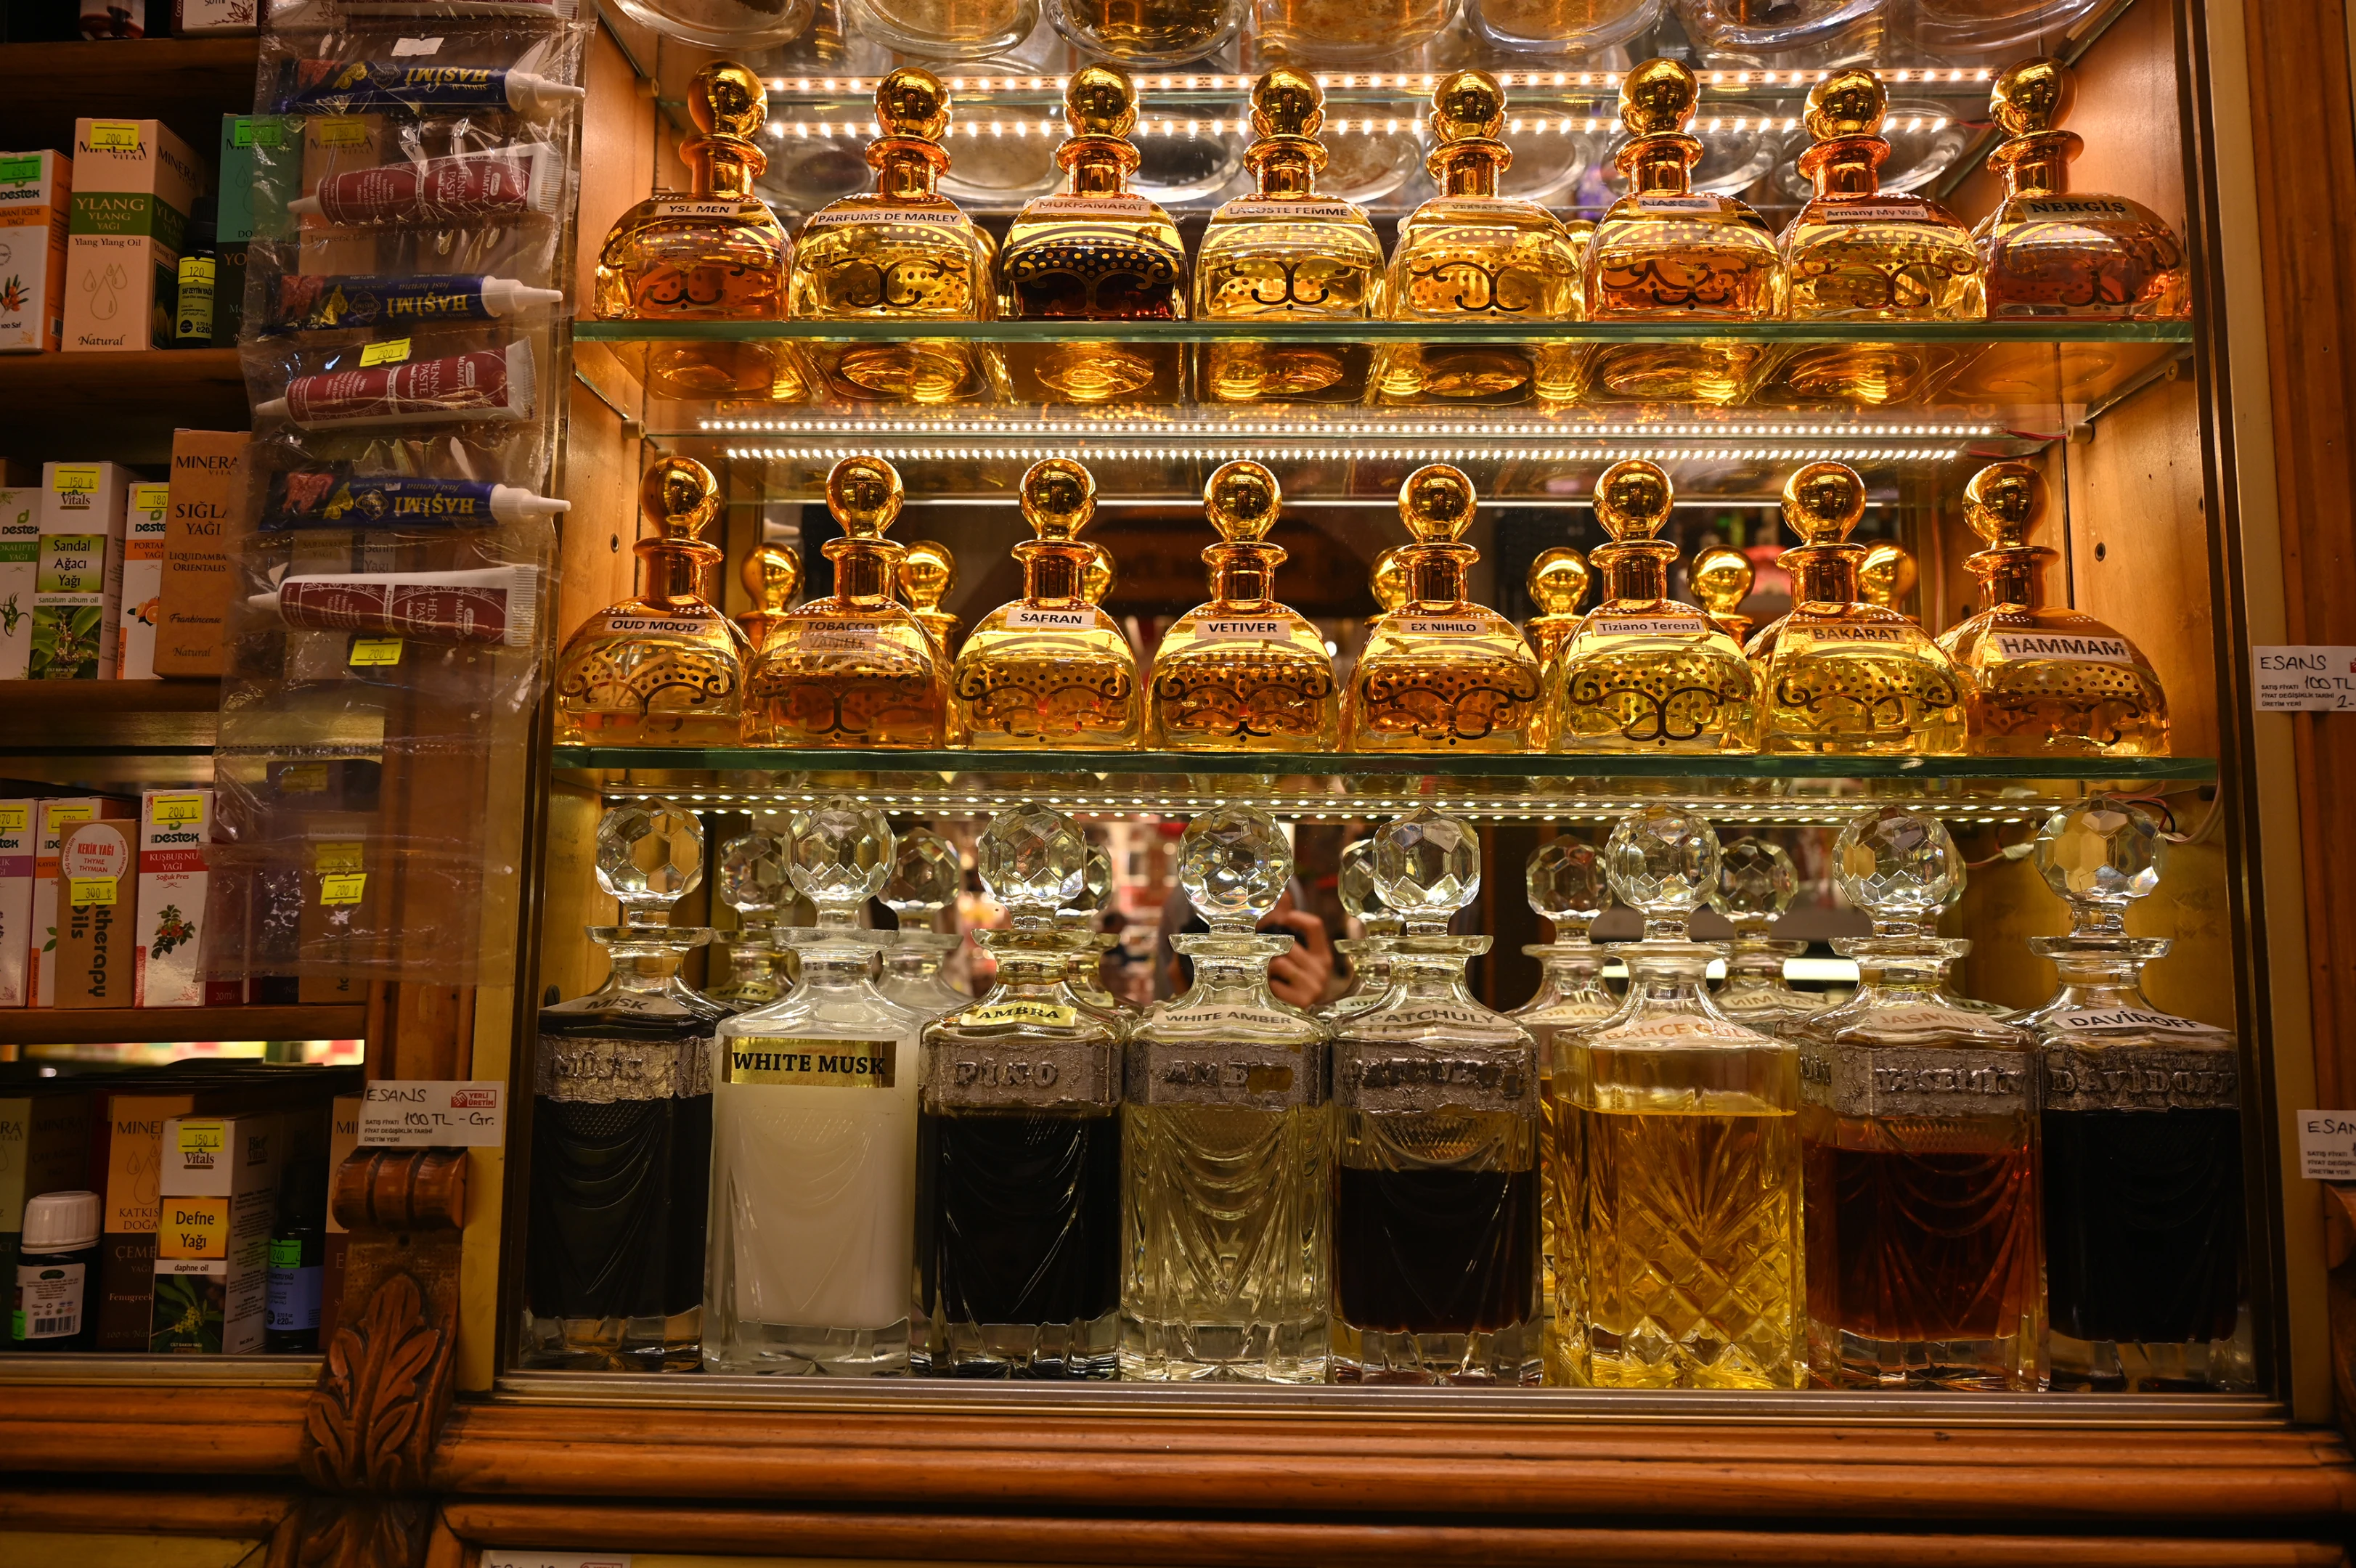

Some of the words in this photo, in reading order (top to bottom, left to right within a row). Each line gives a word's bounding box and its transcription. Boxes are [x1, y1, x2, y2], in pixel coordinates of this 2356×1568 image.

[106, 134, 121, 144] 200
[447, 171, 457, 204] PASTE
[76, 198, 144, 211] YLANG
[696, 205, 730, 214] MEN
[1230, 205, 1291, 215] LACOSTE
[1295, 208, 1348, 216] FEMME
[2029, 200, 2127, 213] NERGİS
[89, 212, 131, 221] YLANG
[818, 213, 880, 223] PARFUMS
[883, 212, 900, 221] DE
[905, 213, 958, 223] MARLEY
[1827, 208, 1875, 219] Armany
[1877, 208, 1896, 219] My
[1897, 208, 1925, 219] Way
[75, 238, 98, 248] Ylang
[101, 238, 124, 248] Ylang
[190, 266, 204, 277] 120
[387, 292, 468, 317] HAŞİMİ
[78, 333, 126, 346] Natural
[419, 364, 430, 394] PASTE
[430, 359, 441, 398] HENNA
[70, 477, 83, 488] 150
[407, 483, 438, 492] henna
[441, 483, 462, 492] fast
[62, 494, 90, 505] Vitals
[152, 496, 166, 506] 180
[394, 493, 476, 518] HAŞİMİ
[135, 523, 166, 533] Deste
[186, 520, 221, 535] YAĞI
[54, 540, 90, 552] Sandal
[9, 552, 28, 561] YAĞI
[169, 552, 227, 561] LIQUIDAMBA
[54, 558, 86, 571] Ağacı
[174, 563, 227, 572] ORIENTALIS
[59, 574, 81, 588] Yağı
[169, 613, 221, 625] Frankincense
[1019, 613, 1083, 624] SAFRAN
[611, 619, 645, 629] OUD
[649, 621, 698, 632] MOOD
[807, 621, 876, 631] TOBACCO
[1207, 622, 1278, 633] VETIVER
[1411, 623, 1427, 632] EX
[1430, 623, 1477, 632] NIHILO
[1599, 621, 1649, 632] Tiziano
[1652, 621, 1702, 631] Terenzi
[1811, 627, 1902, 642] BAKARAT
[173, 645, 213, 658] Natural
[2003, 637, 2126, 656] HAMMAM
[2261, 654, 2326, 670] ESANS
[2305, 675, 2331, 689] 100
[2332, 678, 2356, 690] TL
[168, 807, 184, 817] 200
[78, 842, 96, 855] KEKİK
[99, 844, 114, 856] YAĞI
[150, 852, 198, 862] KUŞBURNU
[162, 862, 182, 871] YAĞI
[86, 888, 100, 898] 300
[335, 885, 349, 896] 200
[585, 994, 648, 1010] MİSK
[977, 1007, 1060, 1019] AMBRA
[1165, 1012, 1221, 1022] WHITE
[1227, 1011, 1292, 1024] AMBER
[1369, 1009, 1495, 1024] PATCHULY
[2067, 1010, 2198, 1028] DAVİDOFF
[1882, 1012, 1991, 1027] JASMINE
[733, 1052, 811, 1071] WHITE
[818, 1055, 886, 1074] MUSK
[367, 1088, 426, 1103] ESANS
[404, 1112, 428, 1125] 100
[431, 1114, 454, 1126] TL
[2307, 1119, 2356, 1135] ESAN
[195, 1135, 208, 1146] 150
[184, 1151, 214, 1164] Vitals
[176, 1211, 214, 1225] Defne
[181, 1233, 207, 1250] Yağı
[273, 1250, 285, 1261] 240
[174, 1265, 199, 1273] daphne
[110, 1293, 153, 1302] Fenugreek
